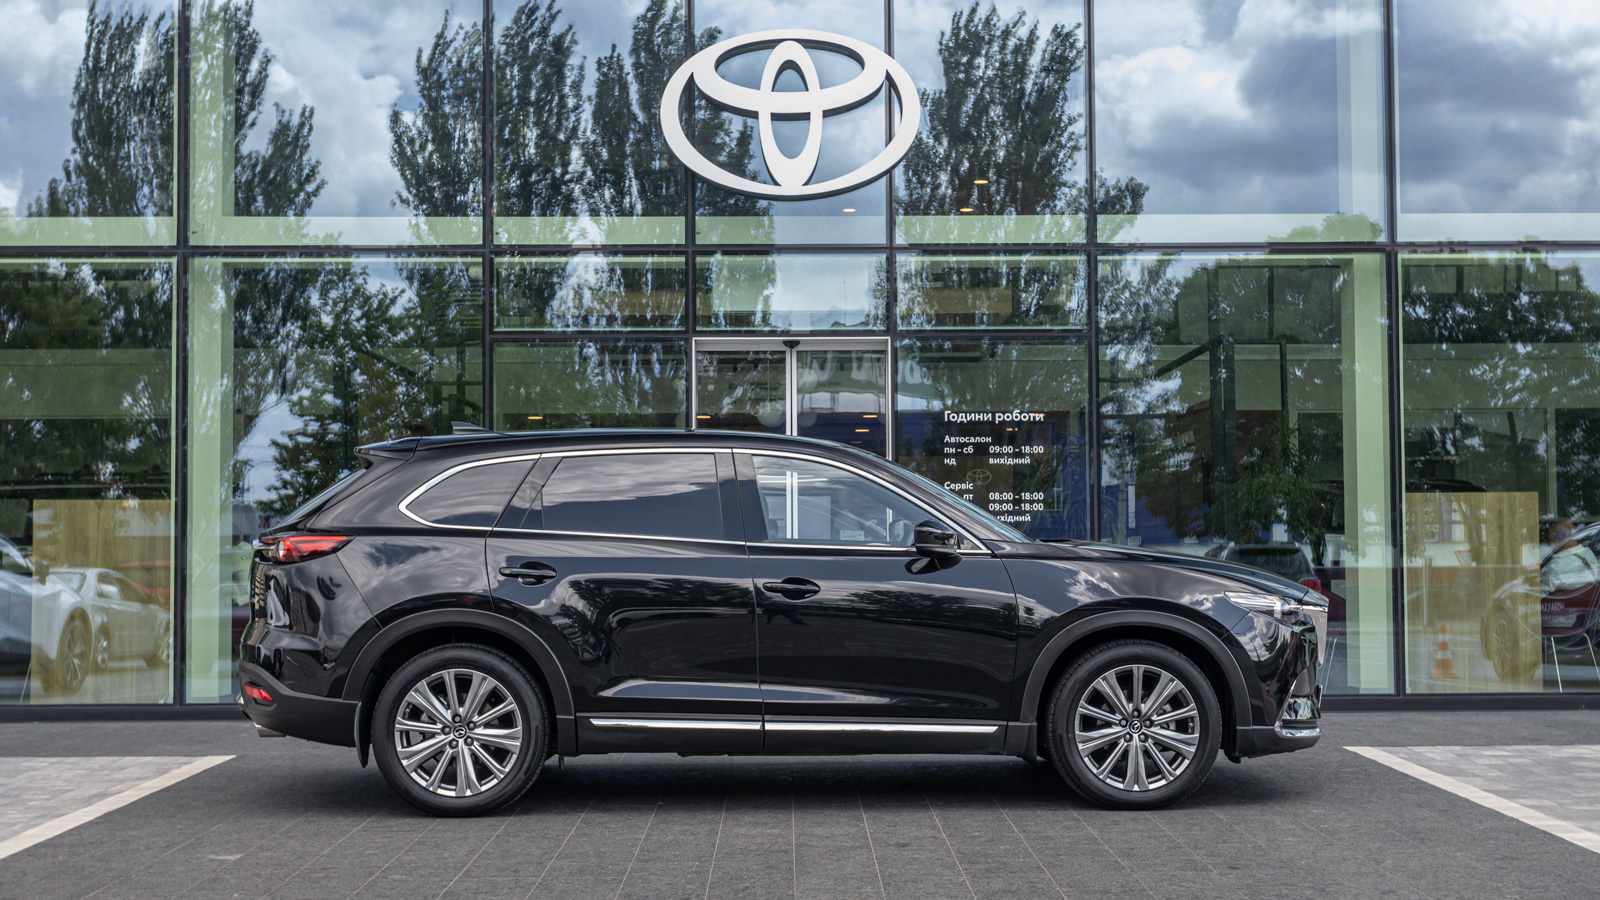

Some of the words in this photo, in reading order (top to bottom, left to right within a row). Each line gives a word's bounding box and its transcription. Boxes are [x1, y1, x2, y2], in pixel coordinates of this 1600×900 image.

[944, 411, 992, 423] Години
[995, 410, 1044, 423] роботи
[944, 435, 992, 443] Автосалон
[944, 446, 956, 454] пн
[963, 445, 974, 454] сб
[989, 445, 1014, 454] 09:00
[1021, 445, 1044, 454] 18:00
[989, 455, 1031, 465] вихідний
[944, 481, 974, 491] Сервіс
[989, 492, 1014, 501] 08:00
[1021, 492, 1044, 501] 18:00
[989, 503, 1014, 511] 09:00
[1021, 503, 1044, 511] 18:00
[996, 513, 1031, 523] хідний
